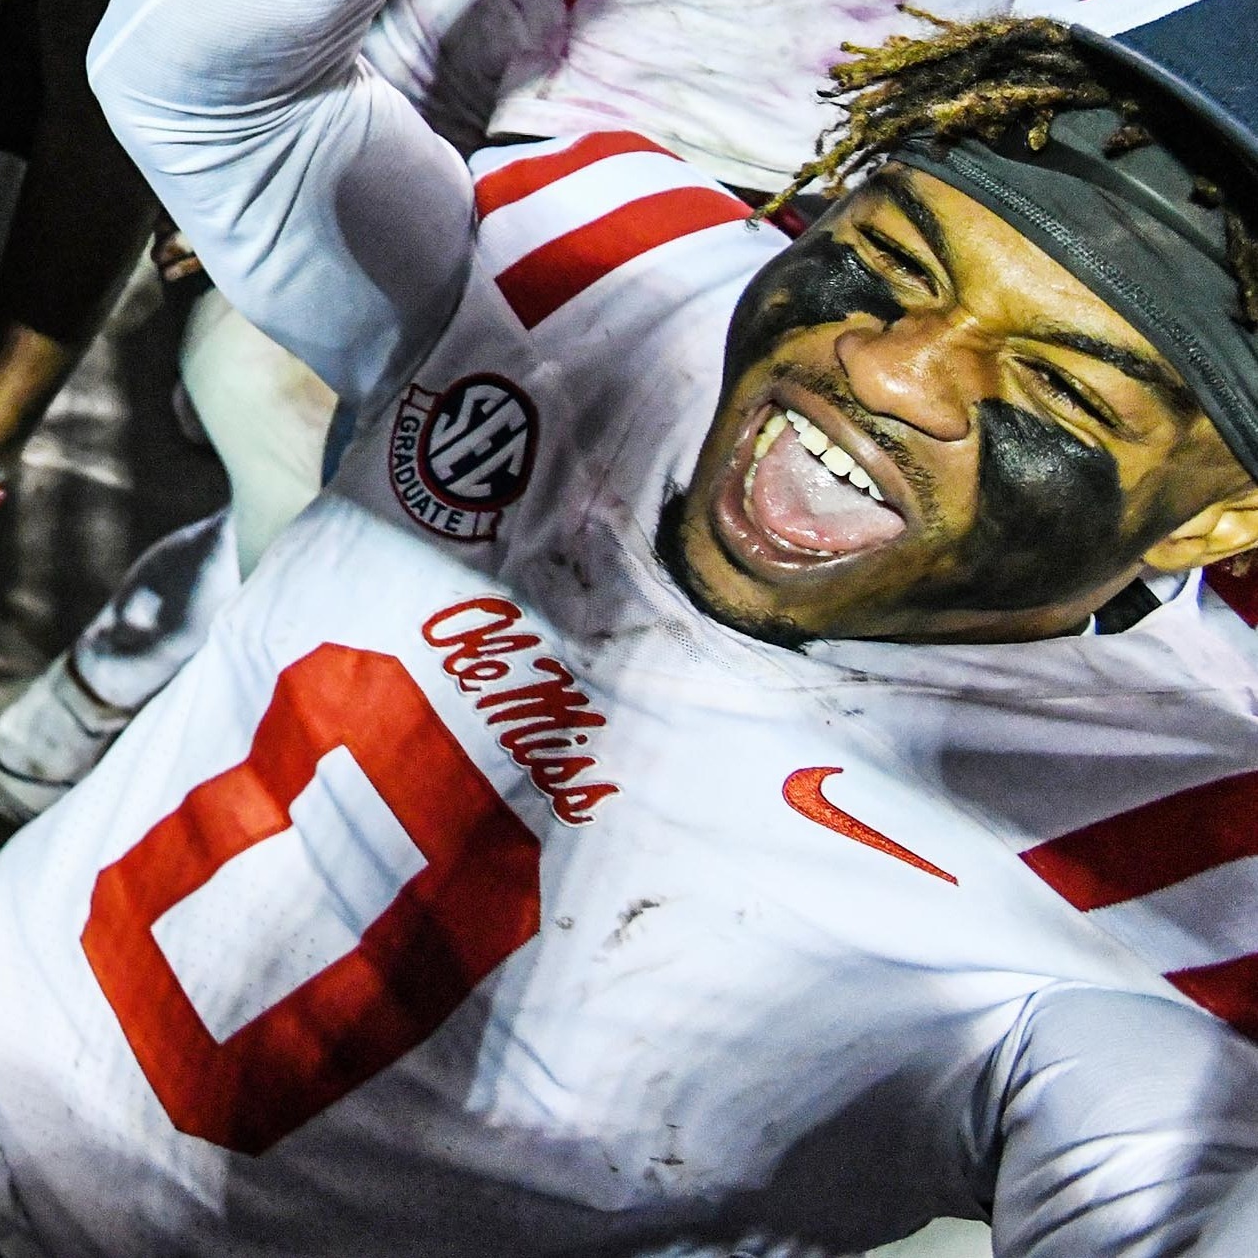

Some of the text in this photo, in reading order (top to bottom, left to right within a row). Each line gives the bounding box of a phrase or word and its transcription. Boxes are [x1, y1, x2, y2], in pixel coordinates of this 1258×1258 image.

[393, 414, 465, 533] GRADUATE
[428, 384, 528, 499] SEC
[421, 596, 622, 826] Ole Miss
[80, 641, 542, 1158] 0
